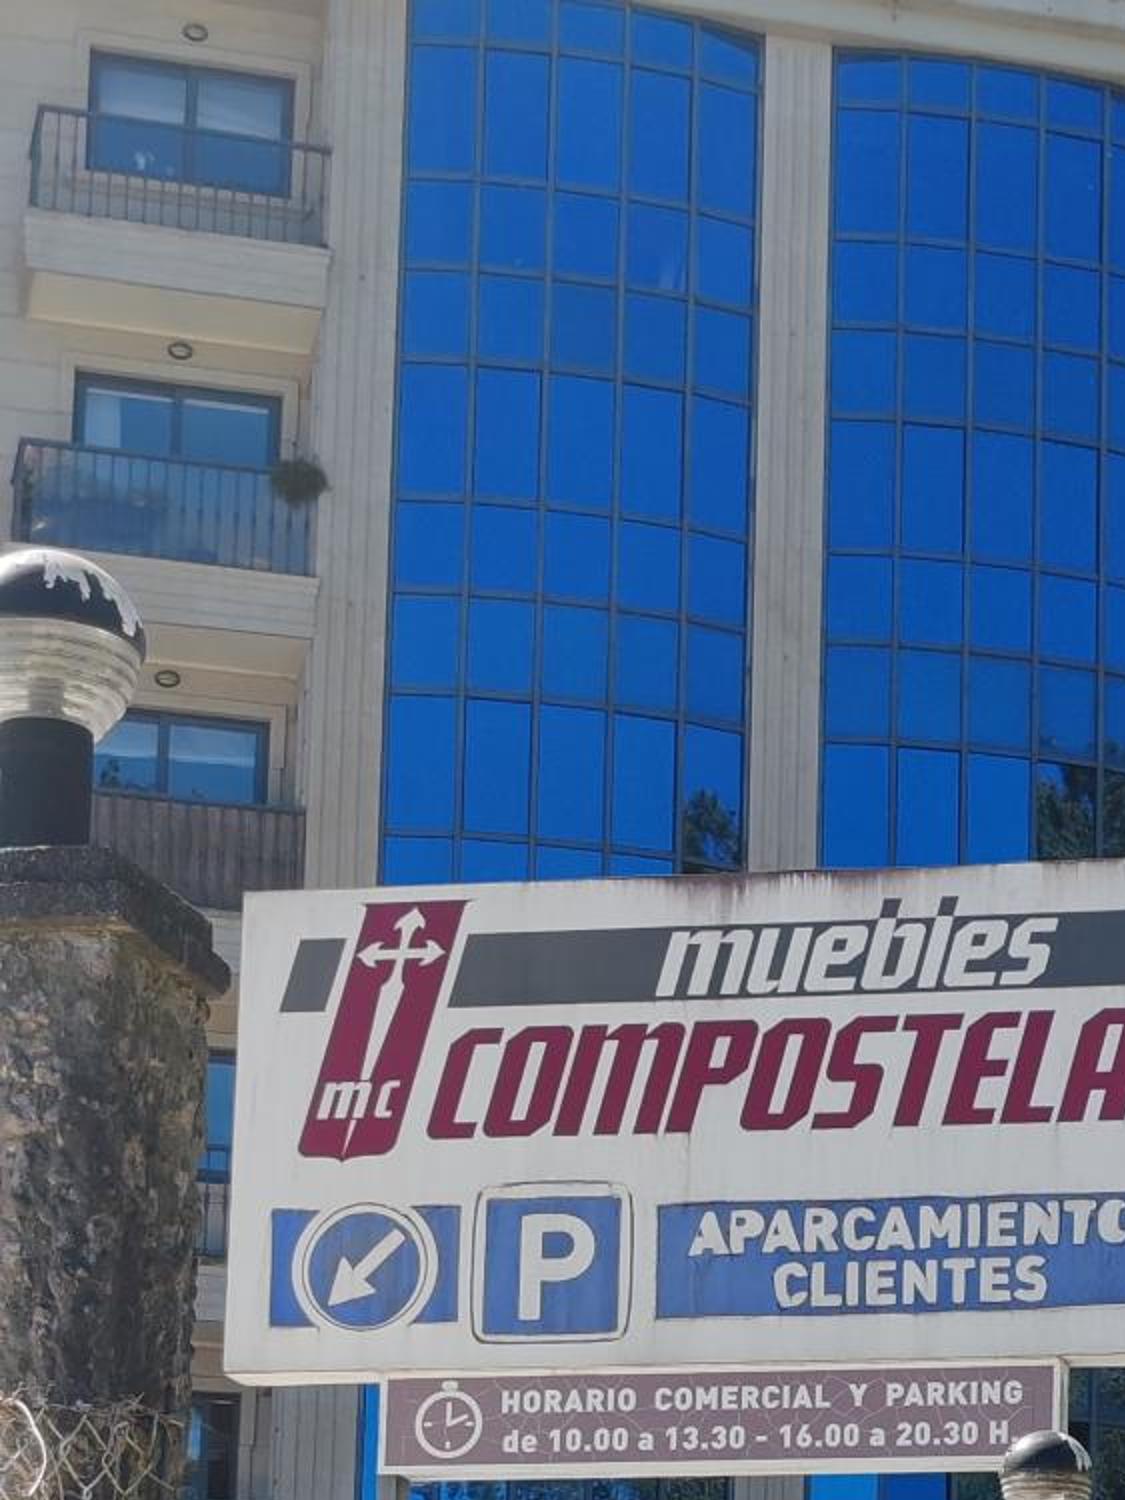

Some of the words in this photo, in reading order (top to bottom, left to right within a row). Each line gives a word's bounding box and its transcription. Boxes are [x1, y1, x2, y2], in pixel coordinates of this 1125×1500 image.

[655, 895, 1058, 998] muebles
[518, 1213, 596, 1321] P
[773, 1255, 1049, 1309] CLIENTES
[501, 1388, 637, 1414] HORARIO
[655, 1384, 831, 1411] COMERCIAL
[850, 1383, 868, 1408] Y
[886, 1380, 1023, 1407] PARKING
[502, 1429, 538, 1453] de
[549, 1427, 629, 1452] 10.00
[637, 1431, 654, 1451] a
[665, 1426, 745, 1450] 13.30
[779, 1423, 860, 1448] 16.00
[869, 1427, 886, 1447] a
[896, 1421, 978, 1446] 20.30
